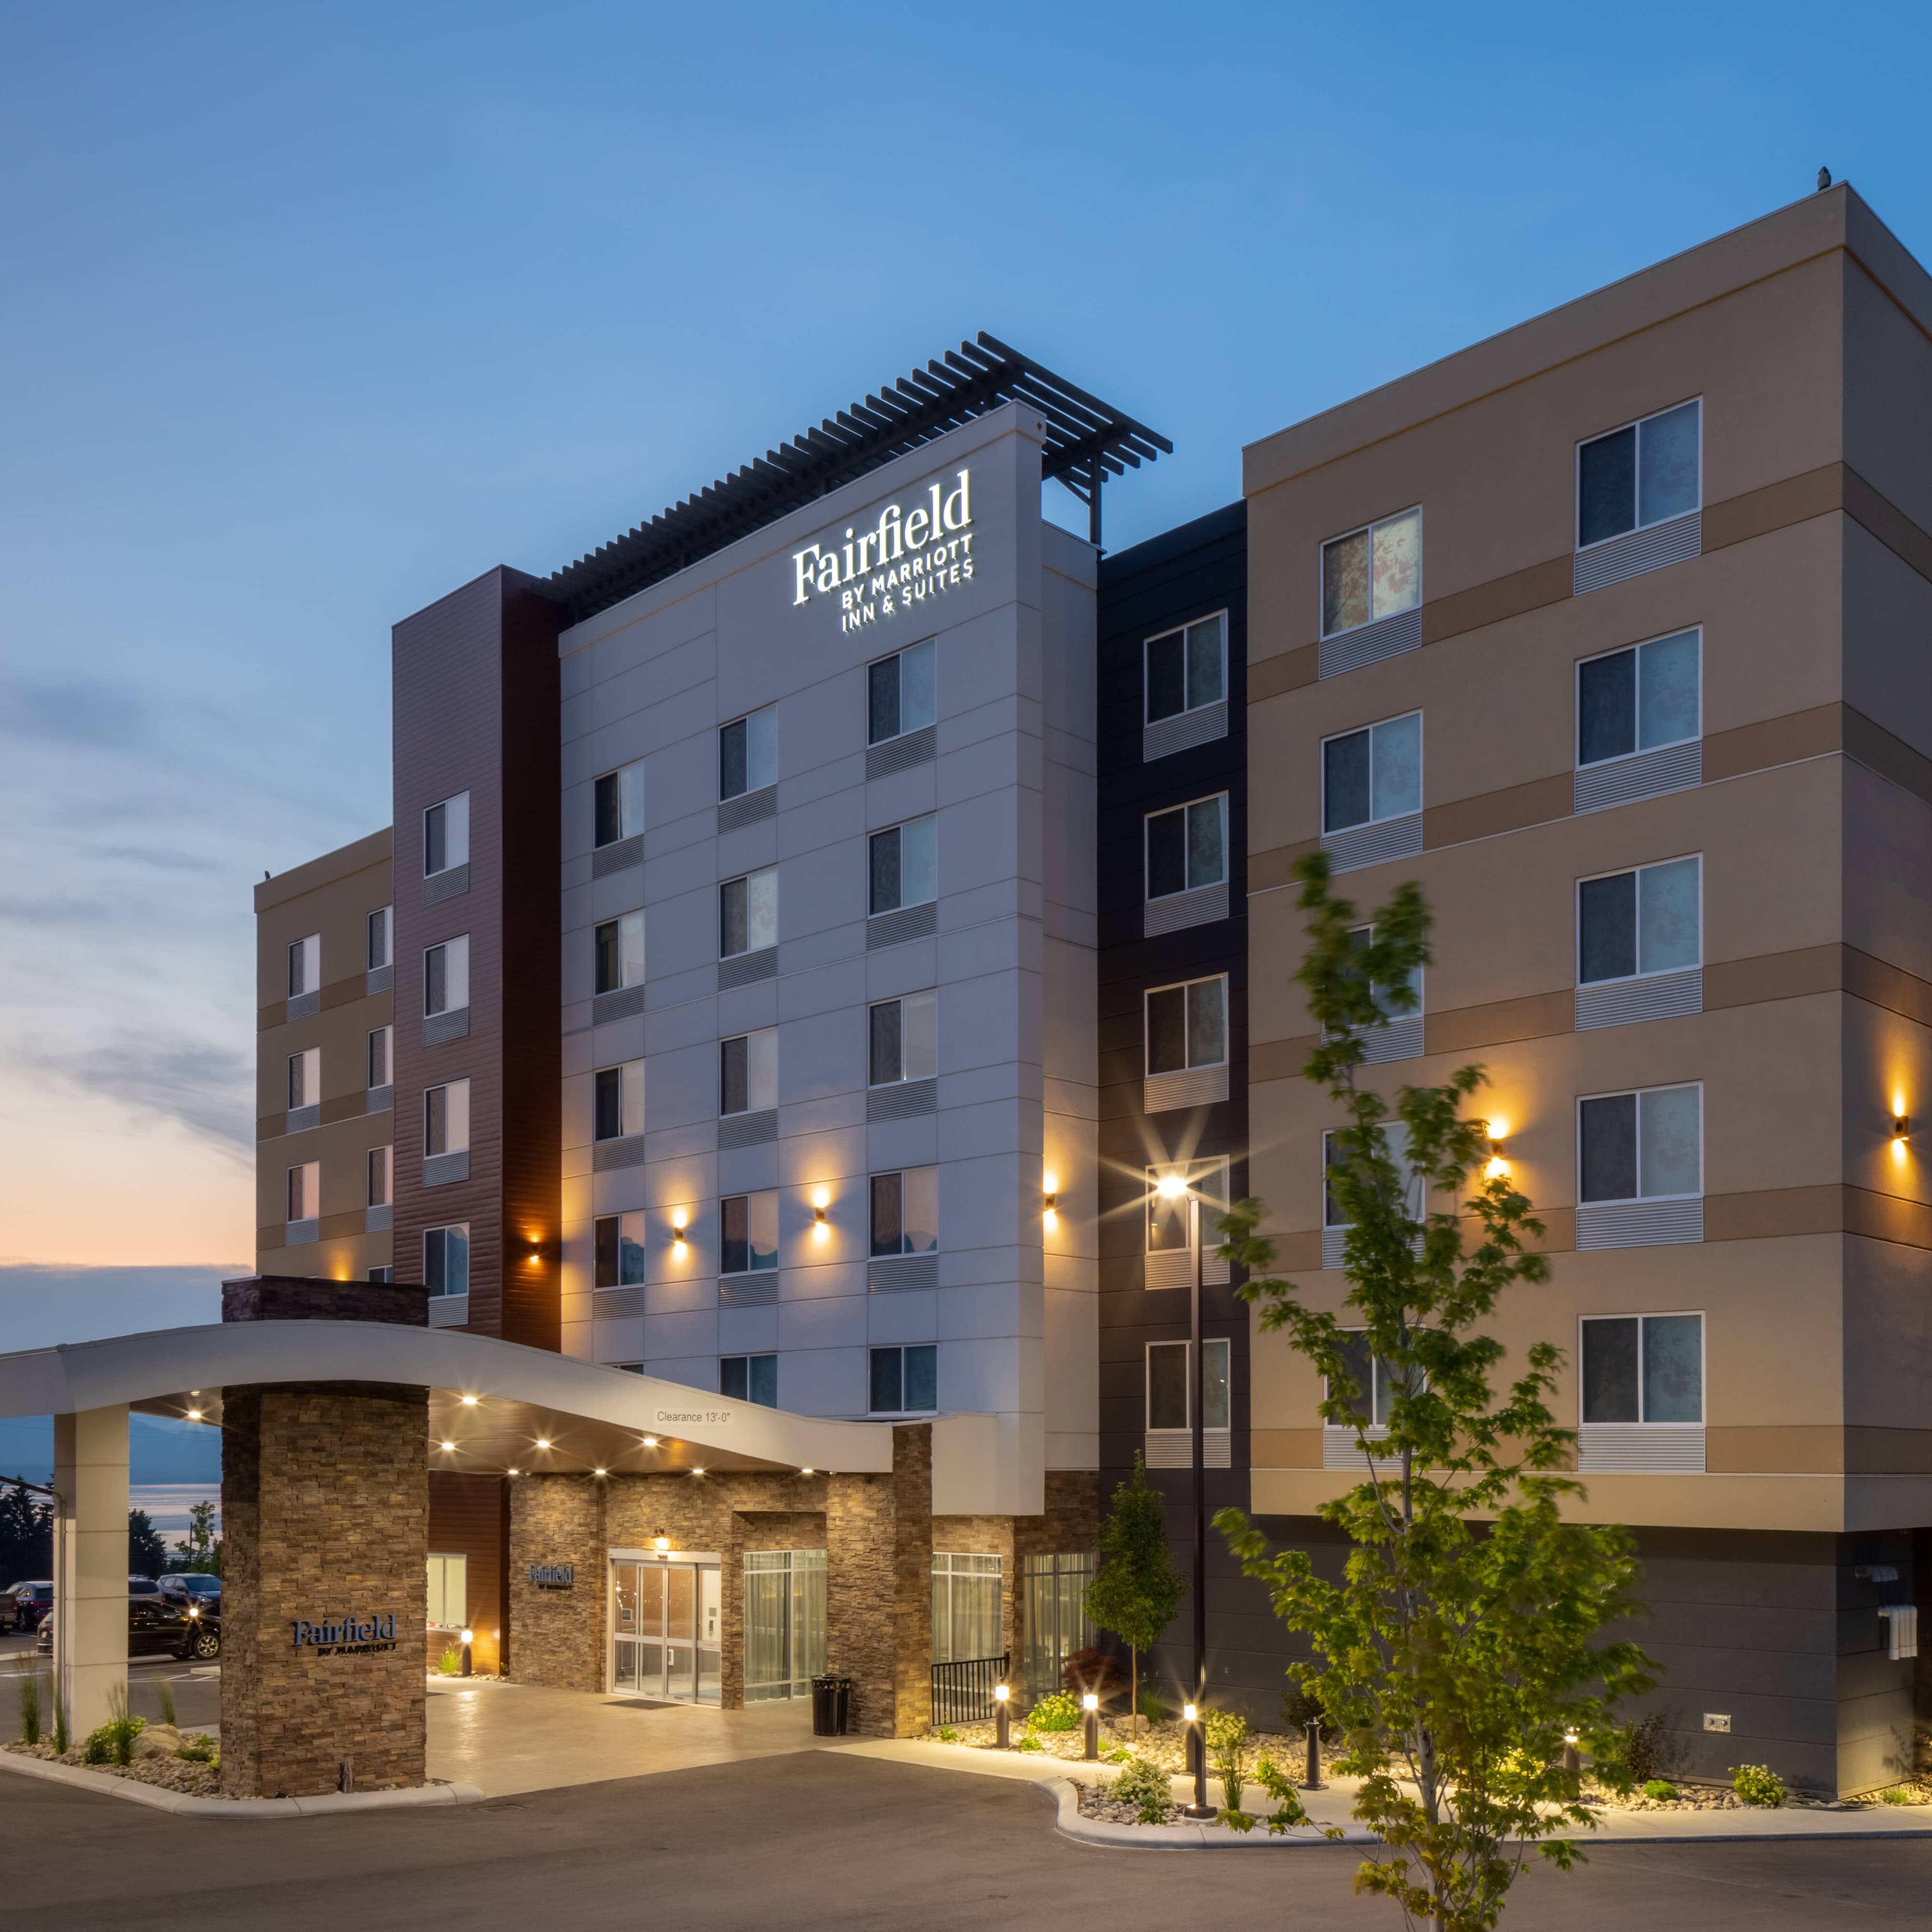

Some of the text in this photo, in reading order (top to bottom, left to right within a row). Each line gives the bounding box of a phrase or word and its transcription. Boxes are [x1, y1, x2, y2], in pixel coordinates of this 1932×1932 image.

[793, 469, 972, 605] Fairfield
[842, 534, 973, 609] BY MARRIOTT
[842, 558, 973, 632] INN & SUITES
[657, 1411, 730, 1422] Clearance 13'-0"
[529, 1563, 573, 1583] Fairfield
[292, 1614, 396, 1646] Fairfield
